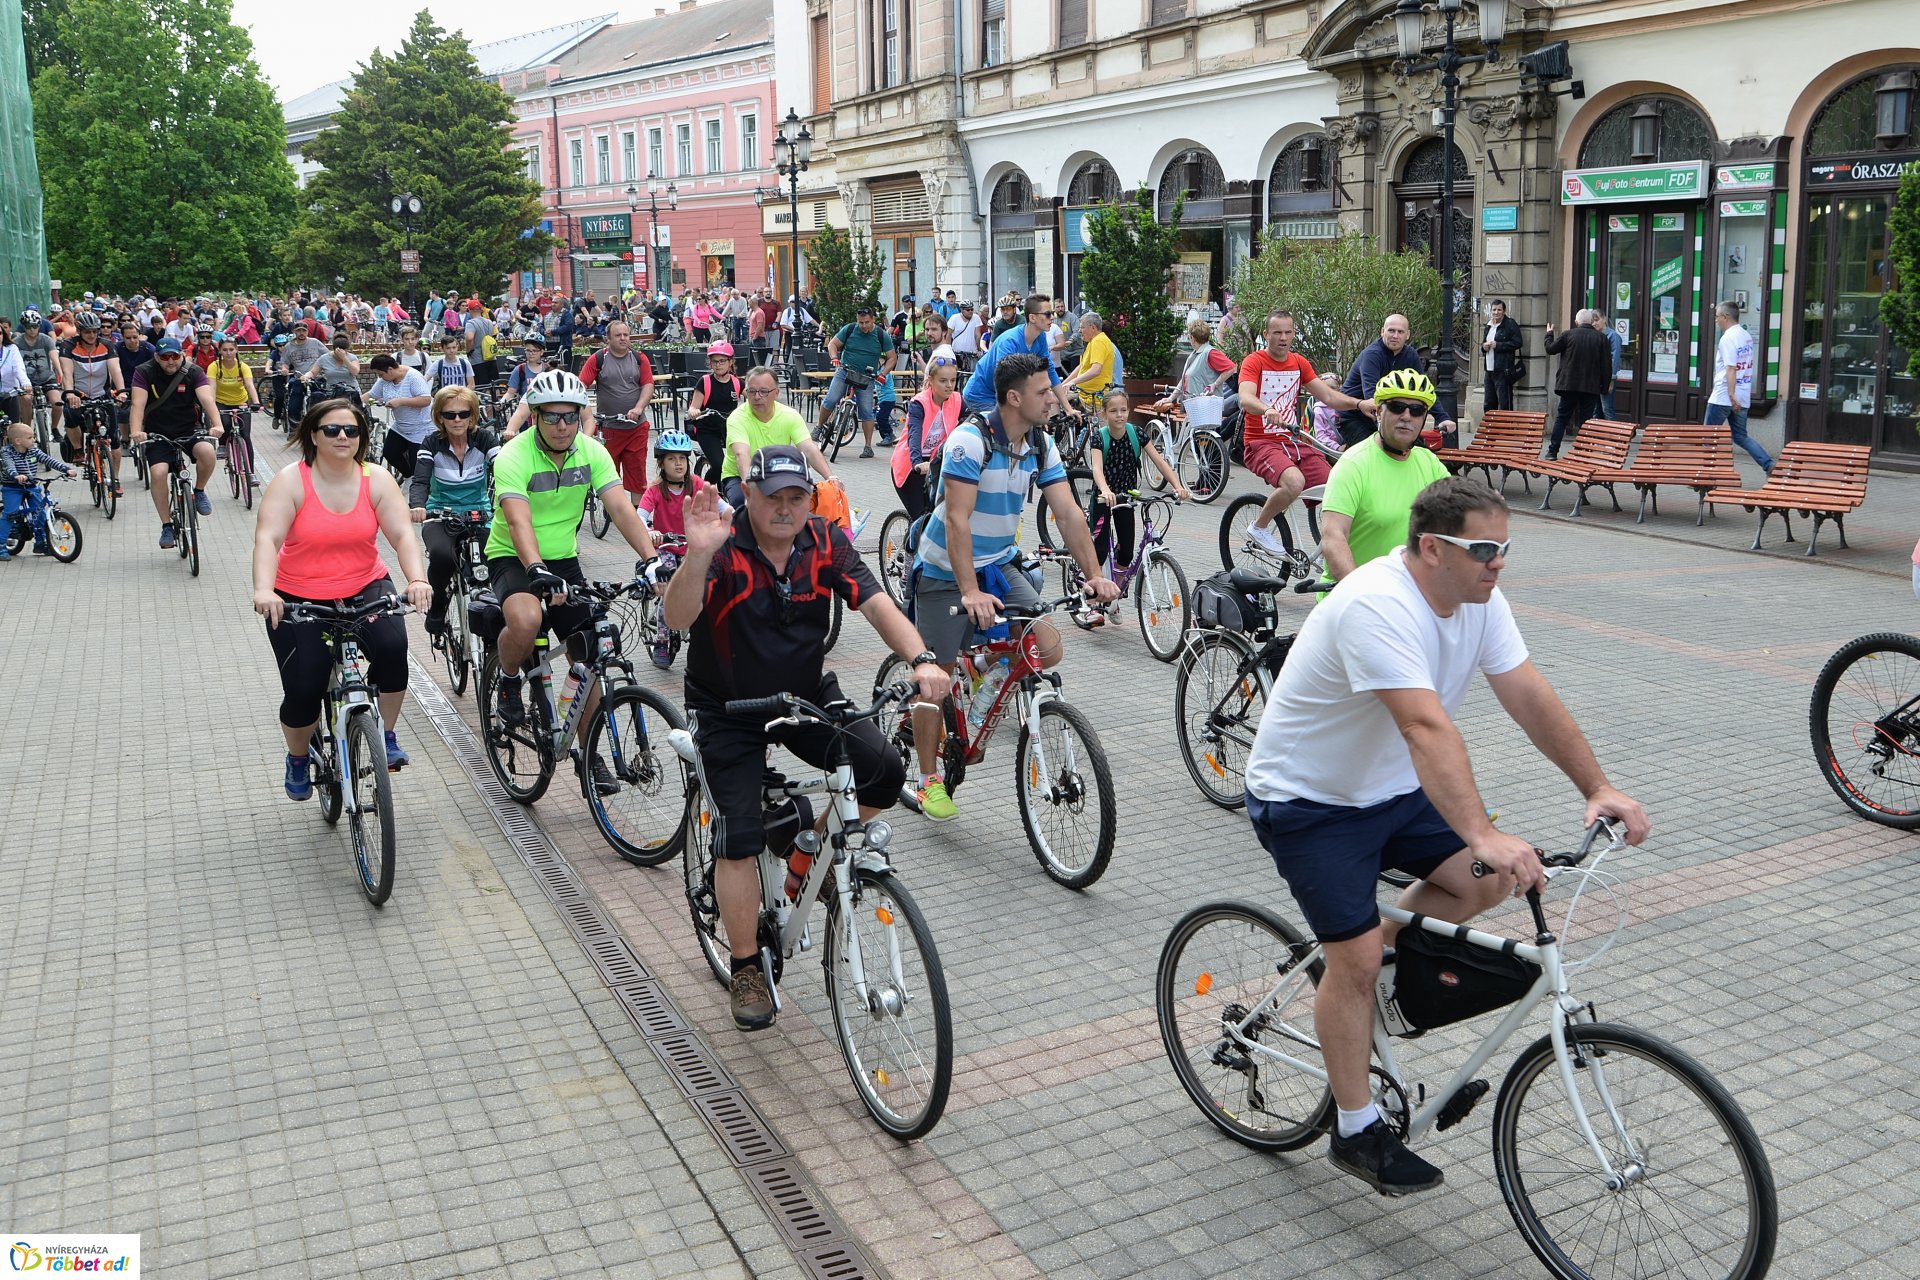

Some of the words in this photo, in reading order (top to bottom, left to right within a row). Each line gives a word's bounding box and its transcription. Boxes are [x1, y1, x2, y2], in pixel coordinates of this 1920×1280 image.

[1668, 172, 1694, 187] FDF
[1755, 172, 1770, 180] FDF
[1595, 179, 1610, 192] Fuji
[1610, 178, 1628, 189] Foto
[1629, 177, 1663, 187] Centrum
[586, 216, 624, 232] NYÍRSÉG
